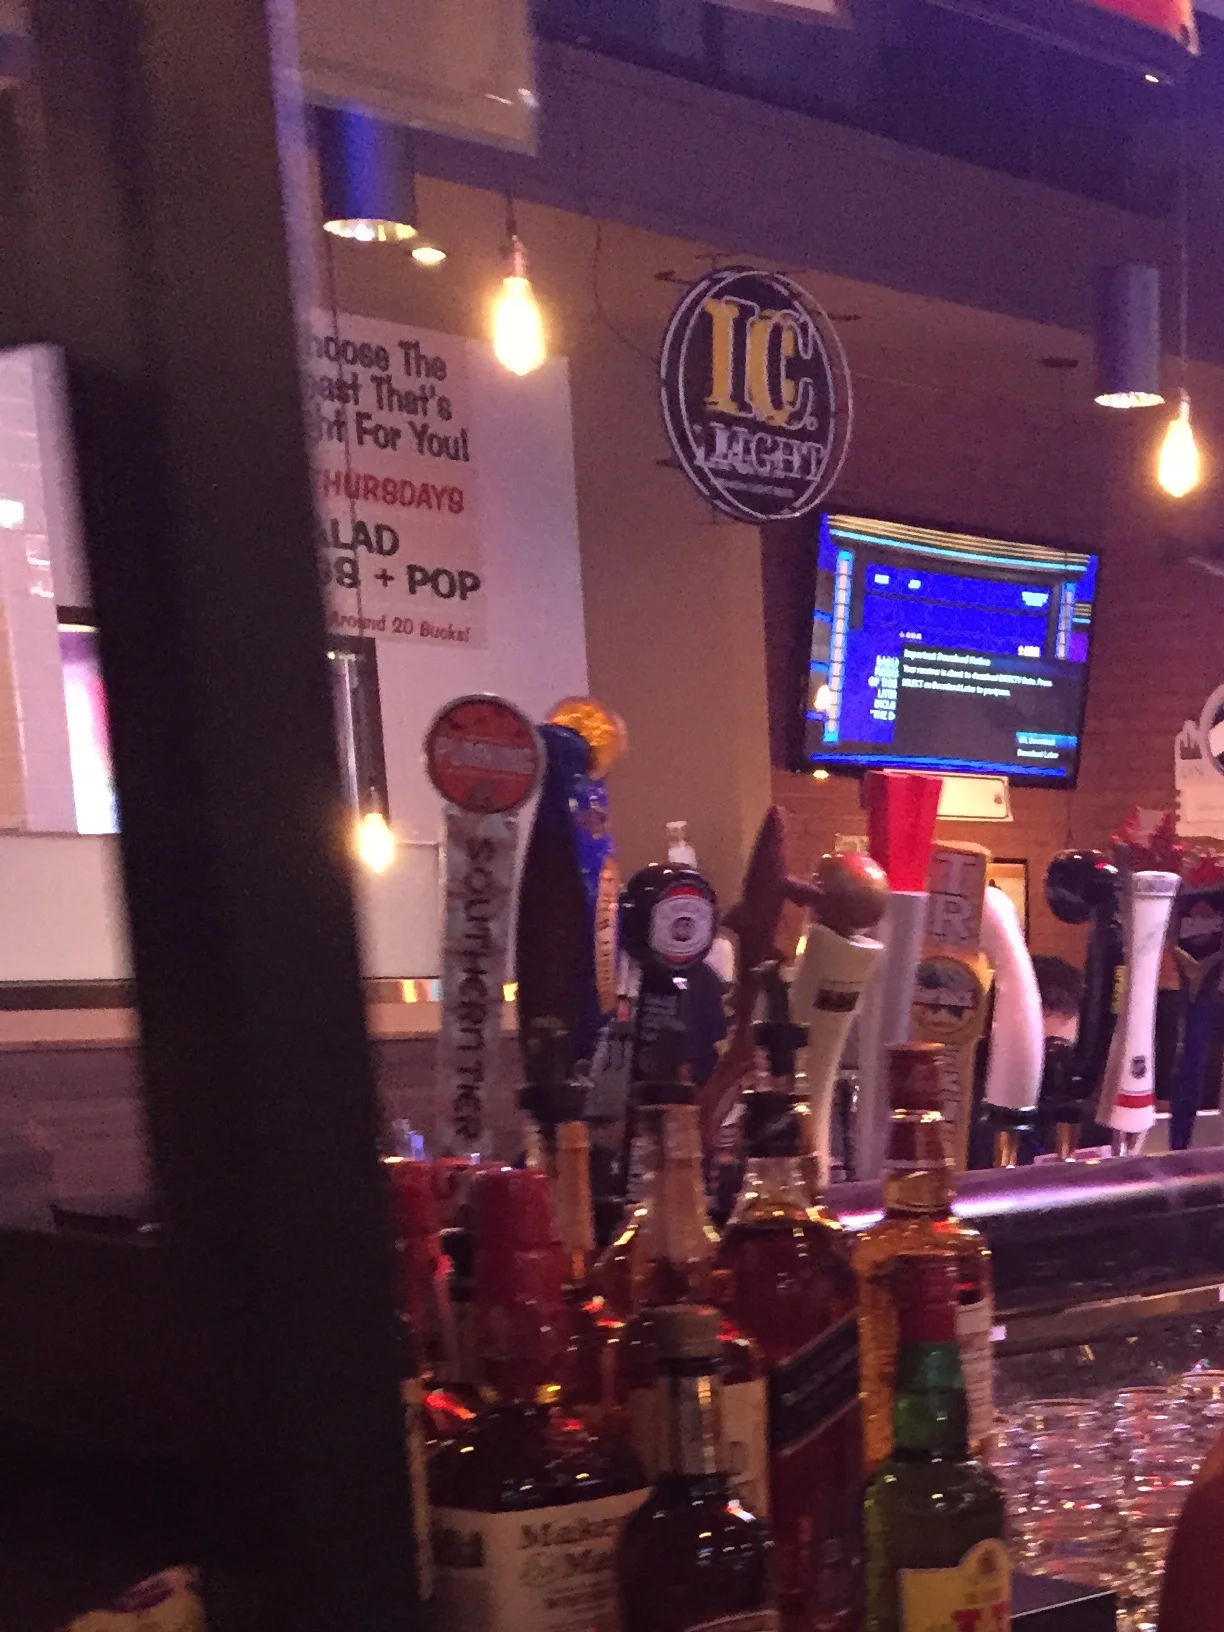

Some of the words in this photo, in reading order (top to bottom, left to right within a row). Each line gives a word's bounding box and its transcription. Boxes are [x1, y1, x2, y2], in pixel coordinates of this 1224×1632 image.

[398, 340, 447, 381] The
[371, 374, 452, 421] That's
[355, 411, 402, 450] For
[408, 420, 470, 462] You!
[406, 563, 481, 601] POP
[392, 616, 414, 635] 20
